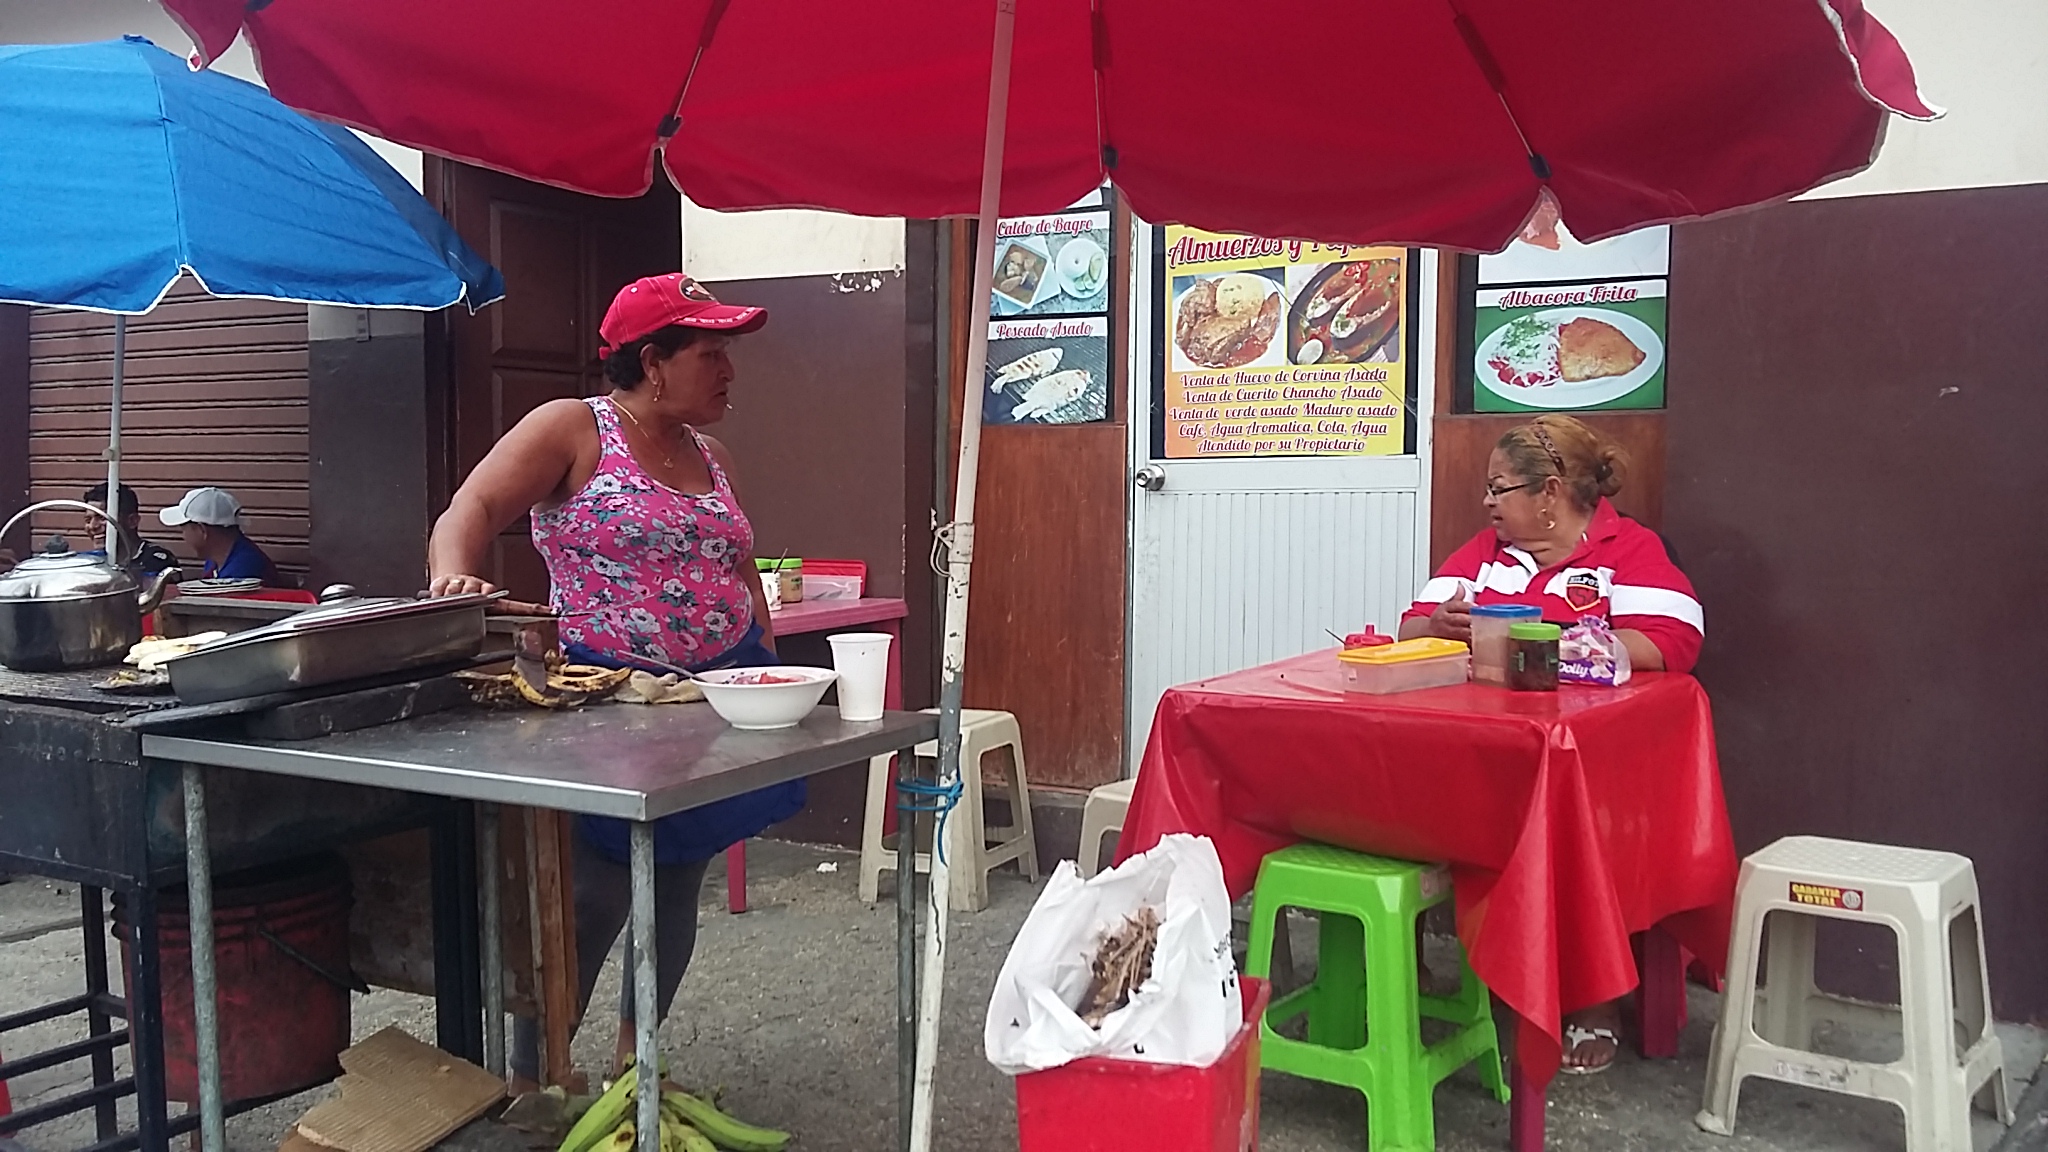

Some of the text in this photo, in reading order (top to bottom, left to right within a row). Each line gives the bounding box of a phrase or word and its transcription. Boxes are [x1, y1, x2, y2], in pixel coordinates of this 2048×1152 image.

[997, 217, 1093, 237] Caldo de Bagre
[1168, 236, 1284, 267] Almuerzos
[1288, 239, 1303, 261] y
[1499, 285, 1638, 309] Albacora Frita
[996, 321, 1093, 339] Pescado Asado
[1180, 367, 1388, 387] Venta de Huevo de Corvina Asada
[1183, 385, 1383, 404] Venta de Cuerito Chancho Asado
[1169, 402, 1398, 420] Venta de verde asado Maduro asado
[1210, 422, 1243, 439] Agua
[1246, 420, 1314, 436] Aromatica,
[1317, 419, 1347, 435] Cola,
[1351, 420, 1388, 438] Agua
[1198, 437, 1365, 454] Atendido por su Propietario
[1791, 883, 1841, 898] GARANTIA
[1796, 893, 1836, 907] TOTAL
